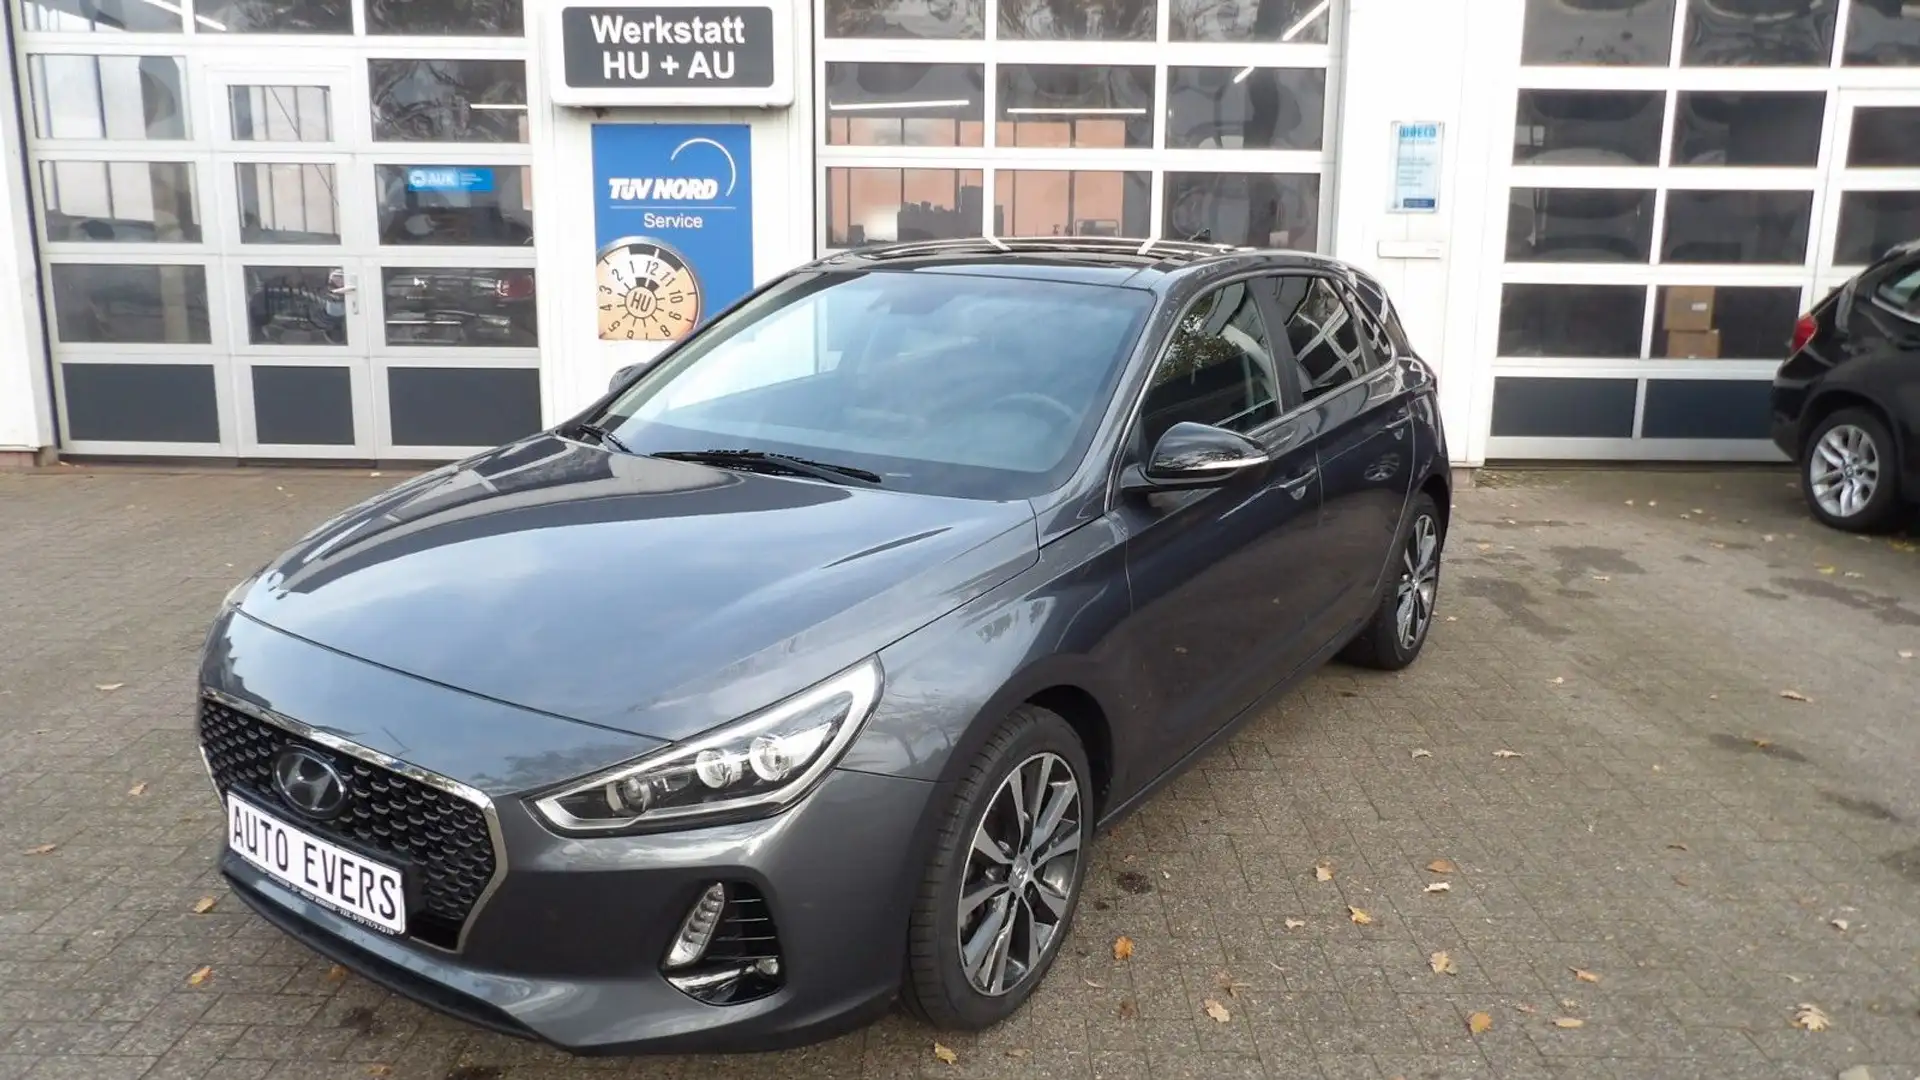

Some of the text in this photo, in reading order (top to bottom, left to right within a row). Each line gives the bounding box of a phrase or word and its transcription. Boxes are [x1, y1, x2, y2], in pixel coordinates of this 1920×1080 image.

[590, 14, 745, 45] Werkstatt
[603, 50, 736, 80] HU + AU
[608, 177, 719, 201] TÜV NORD
[643, 212, 704, 229] Service
[611, 268, 624, 282] 2
[645, 260, 659, 276] 12
[660, 271, 677, 287] 11
[598, 285, 613, 295] 3
[668, 289, 684, 304] 10
[598, 303, 613, 312] 4
[630, 291, 652, 312] HU
[607, 320, 621, 333] 5
[659, 324, 671, 337] 8
[233, 805, 289, 873] AUTO
[303, 841, 397, 921] EVERS
